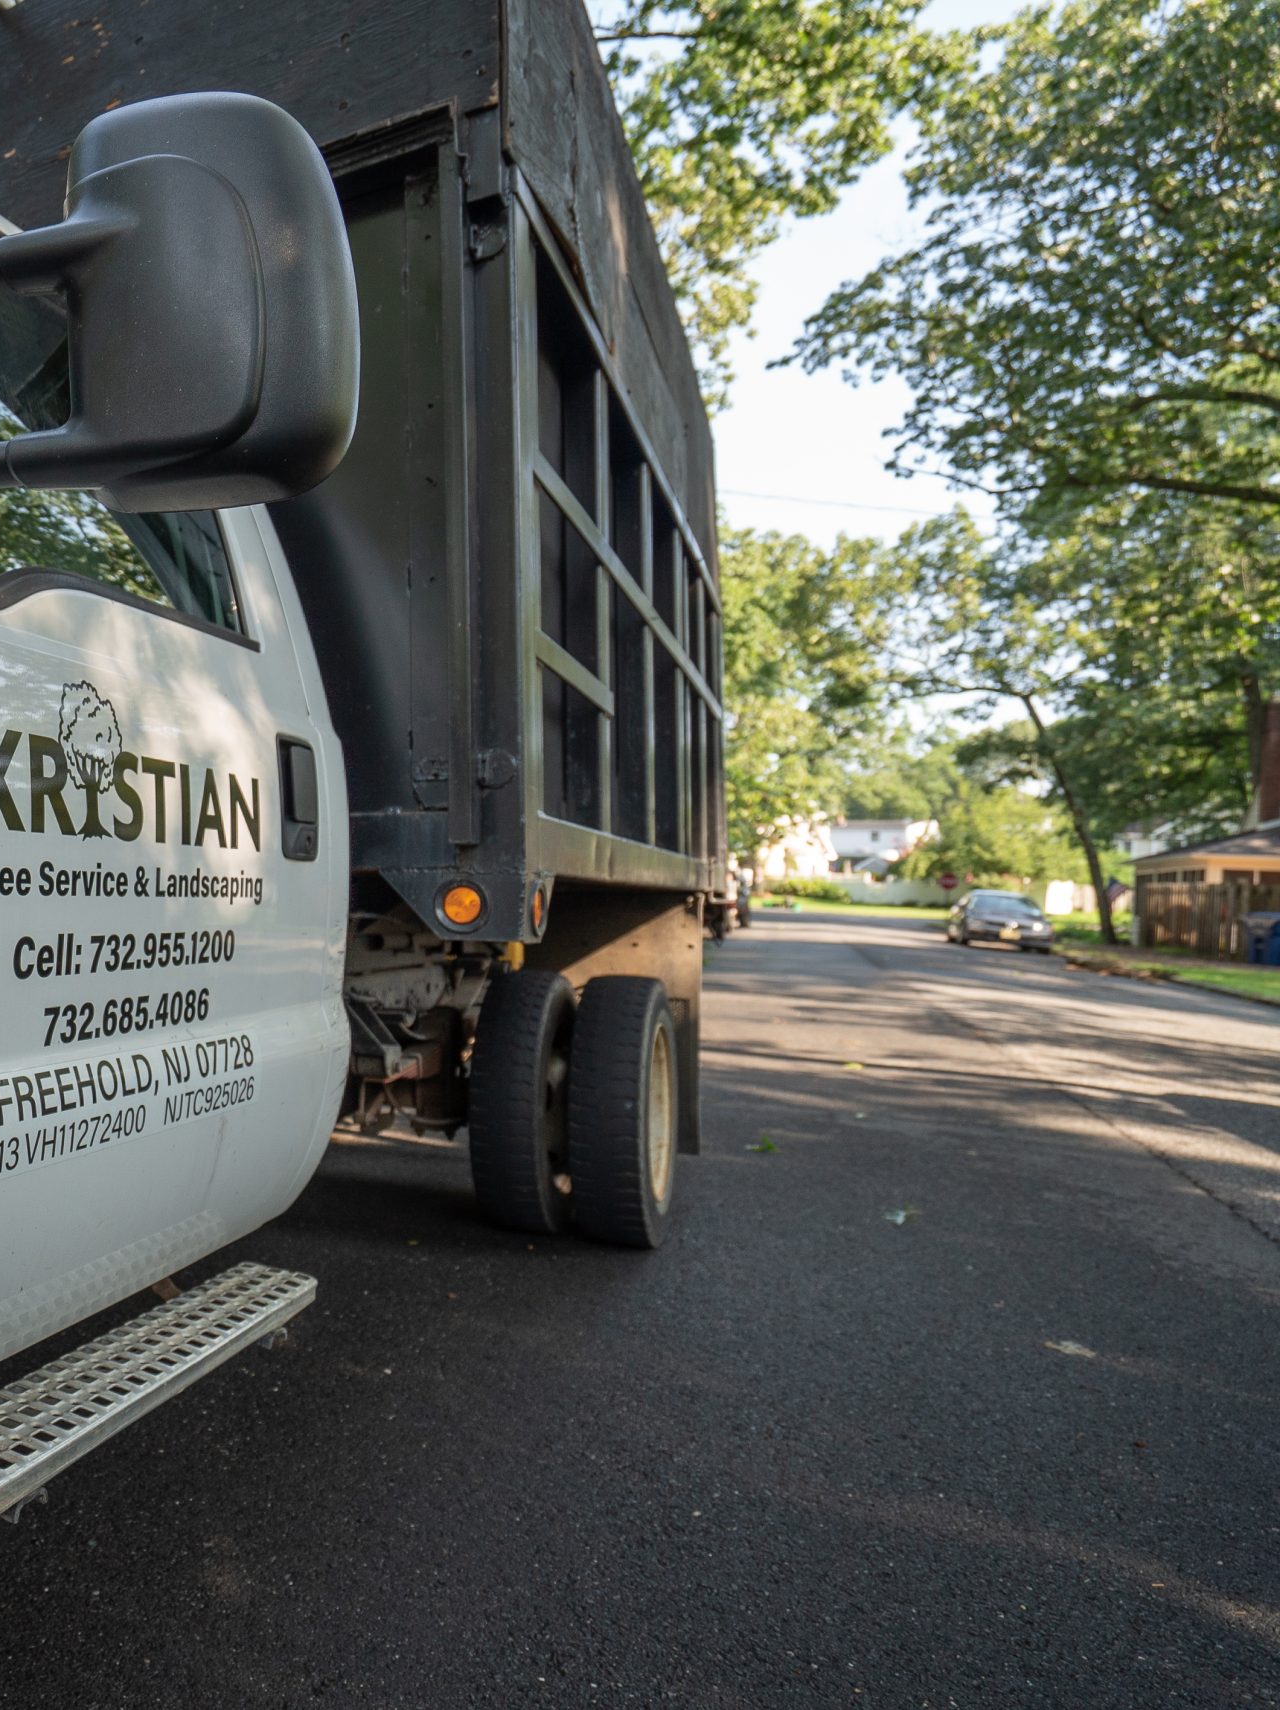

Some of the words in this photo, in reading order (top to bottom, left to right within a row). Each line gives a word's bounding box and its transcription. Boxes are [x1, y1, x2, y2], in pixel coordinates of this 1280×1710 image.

[39, 861, 128, 897] Service
[134, 865, 150, 897] &
[155, 867, 263, 905] Landscaping
[13, 933, 82, 980] Cell:
[89, 929, 236, 974] 732.955.1200
[43, 988, 210, 1047] 732.685.4086
[161, 1045, 191, 1086] NJ
[195, 1034, 255, 1078] 07728
[163, 1076, 255, 1126] NJTC925026
